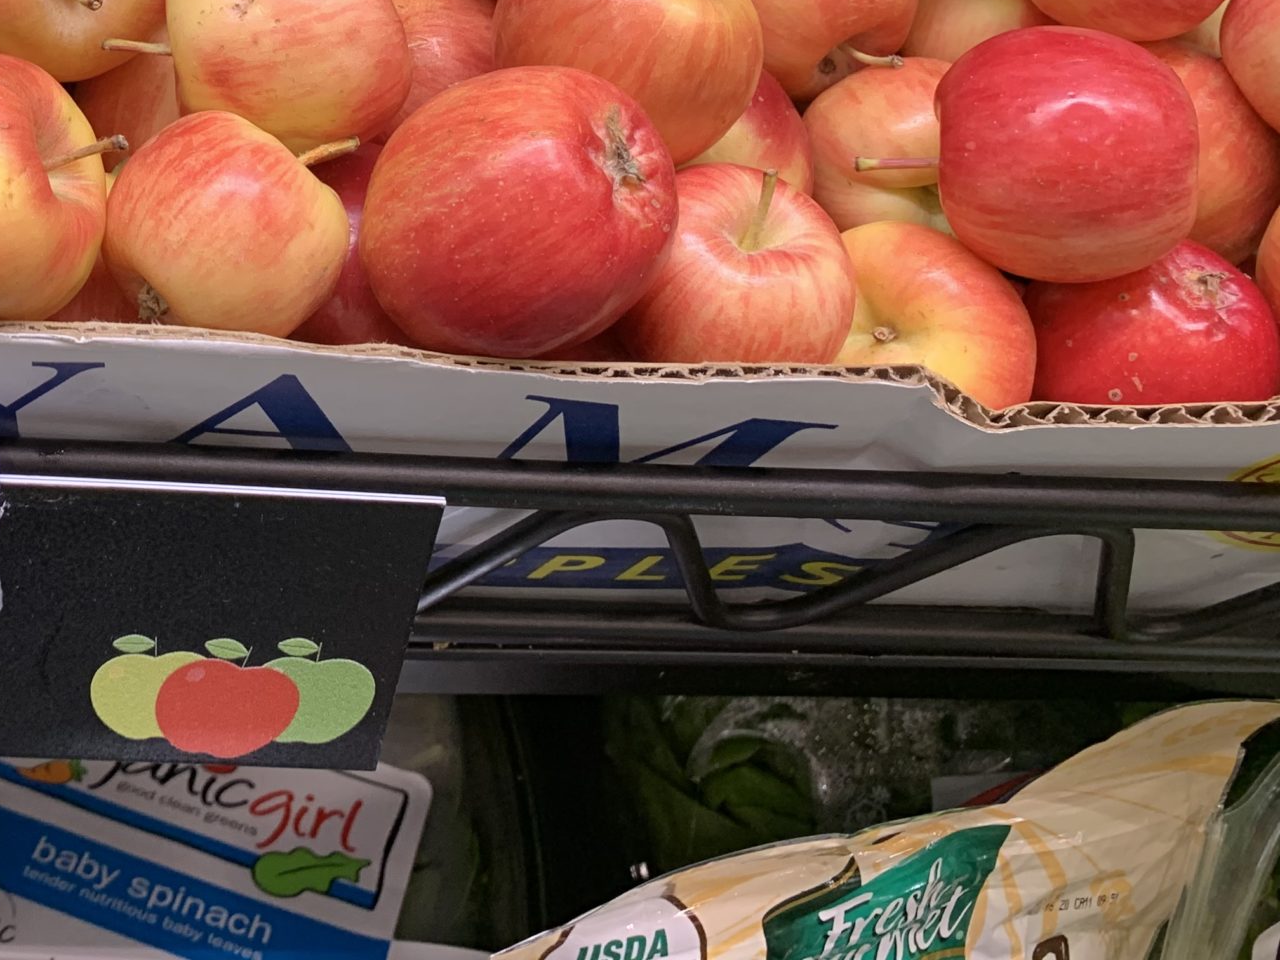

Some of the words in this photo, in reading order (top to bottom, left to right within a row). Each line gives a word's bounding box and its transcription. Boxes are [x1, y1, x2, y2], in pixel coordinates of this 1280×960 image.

[507, 552, 863, 586] PLES
[23, 865, 78, 896] tender
[162, 915, 204, 943] baby
[31, 837, 121, 890] baby
[127, 874, 273, 945] spinach
[817, 857, 953, 958] Fresh
[576, 928, 669, 960] USDA
